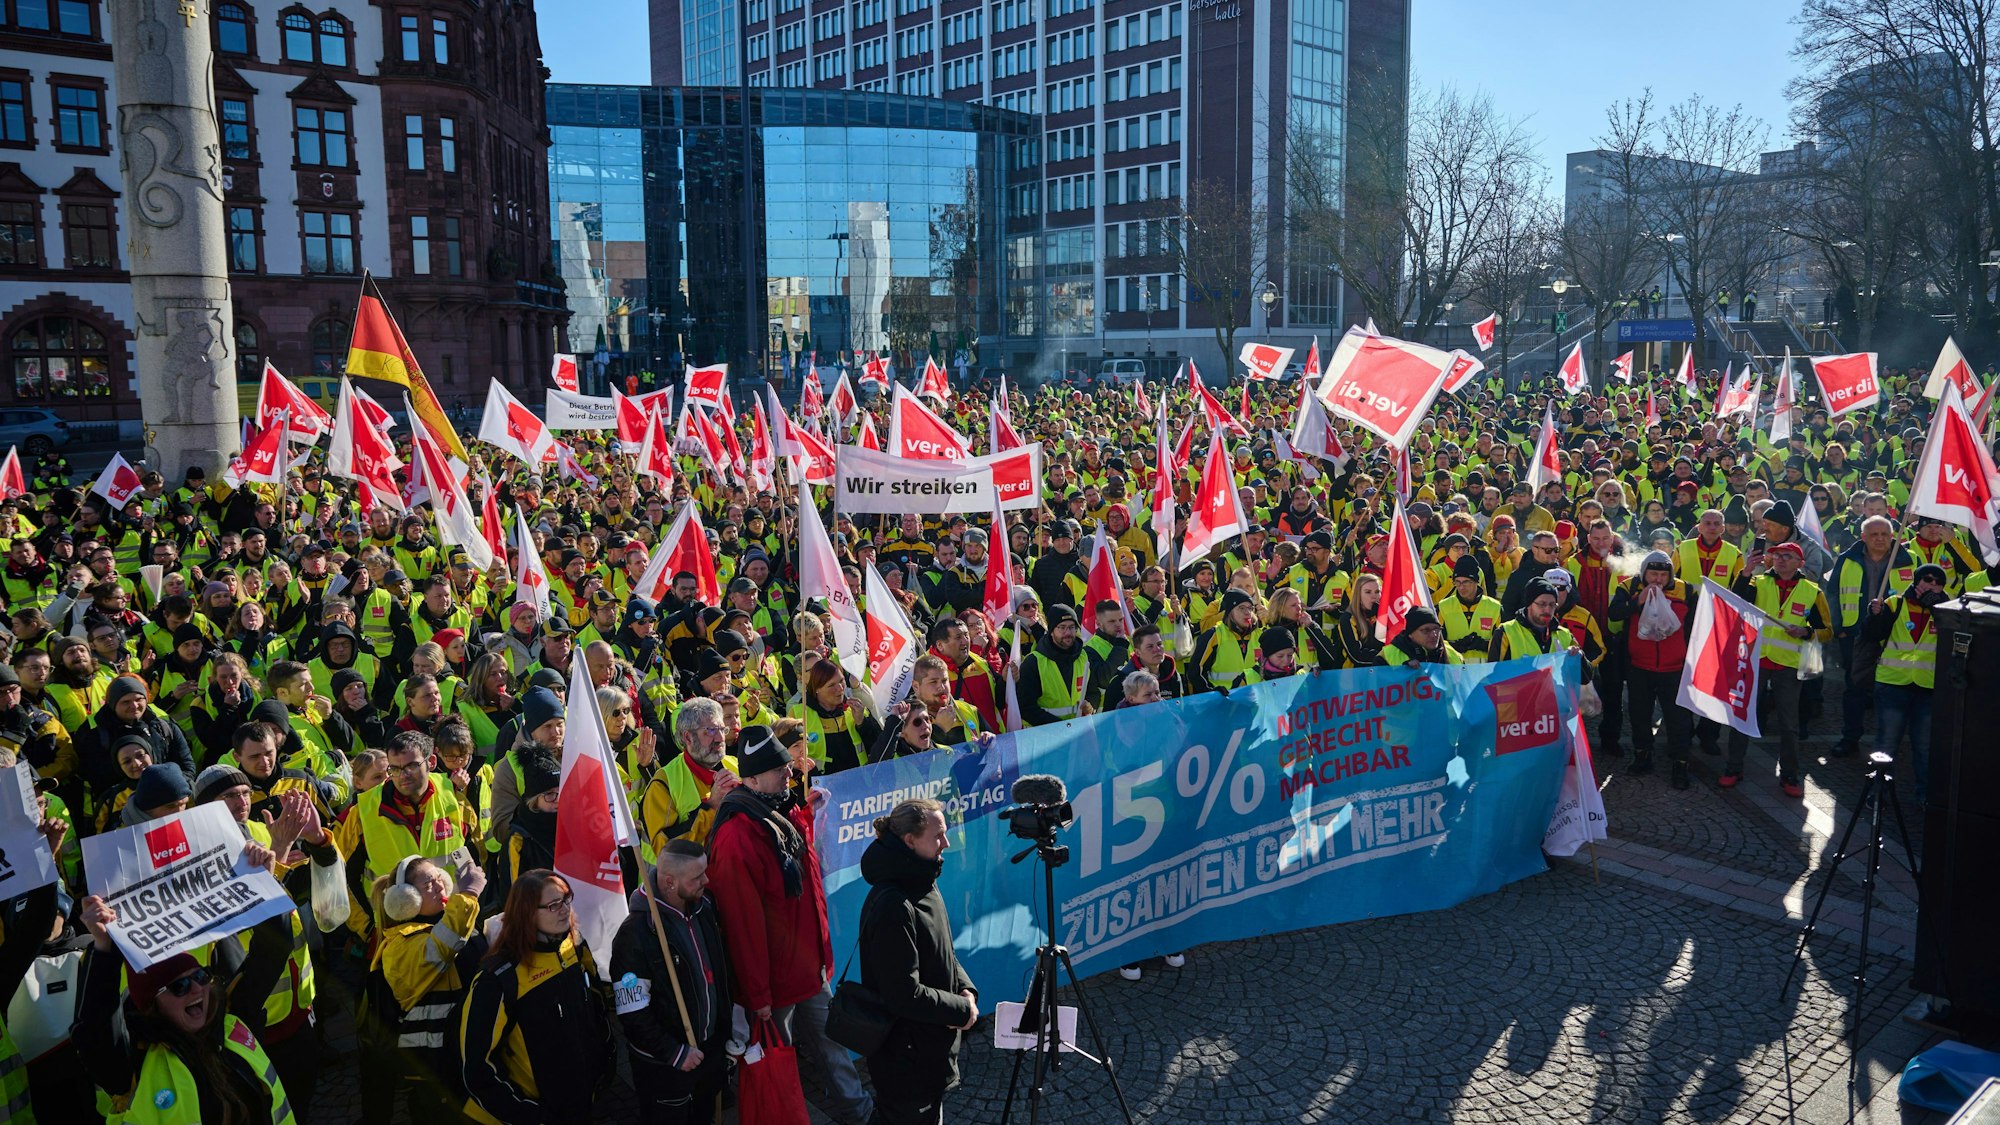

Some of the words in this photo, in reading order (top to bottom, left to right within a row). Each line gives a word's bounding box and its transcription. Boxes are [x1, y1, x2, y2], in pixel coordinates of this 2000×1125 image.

[569, 402, 591, 410] Dieser
[846, 477, 884, 494] Wir
[891, 478, 977, 495] streiken
[1277, 676, 1441, 738] NOTWENDIG,
[1278, 716, 1391, 769] GERECHT,
[840, 777, 952, 820] TARIFRUNDE
[981, 784, 1005, 808] AG
[1280, 744, 1412, 801] MACHBAR
[112, 853, 238, 929] ZUSAMMEN
[1061, 846, 1246, 953] ZUSAMMEN
[1255, 812, 1346, 882] GEHT
[1351, 792, 1446, 852] MEHR
[127, 909, 194, 950] GEHT
[188, 881, 259, 922] MEHR
